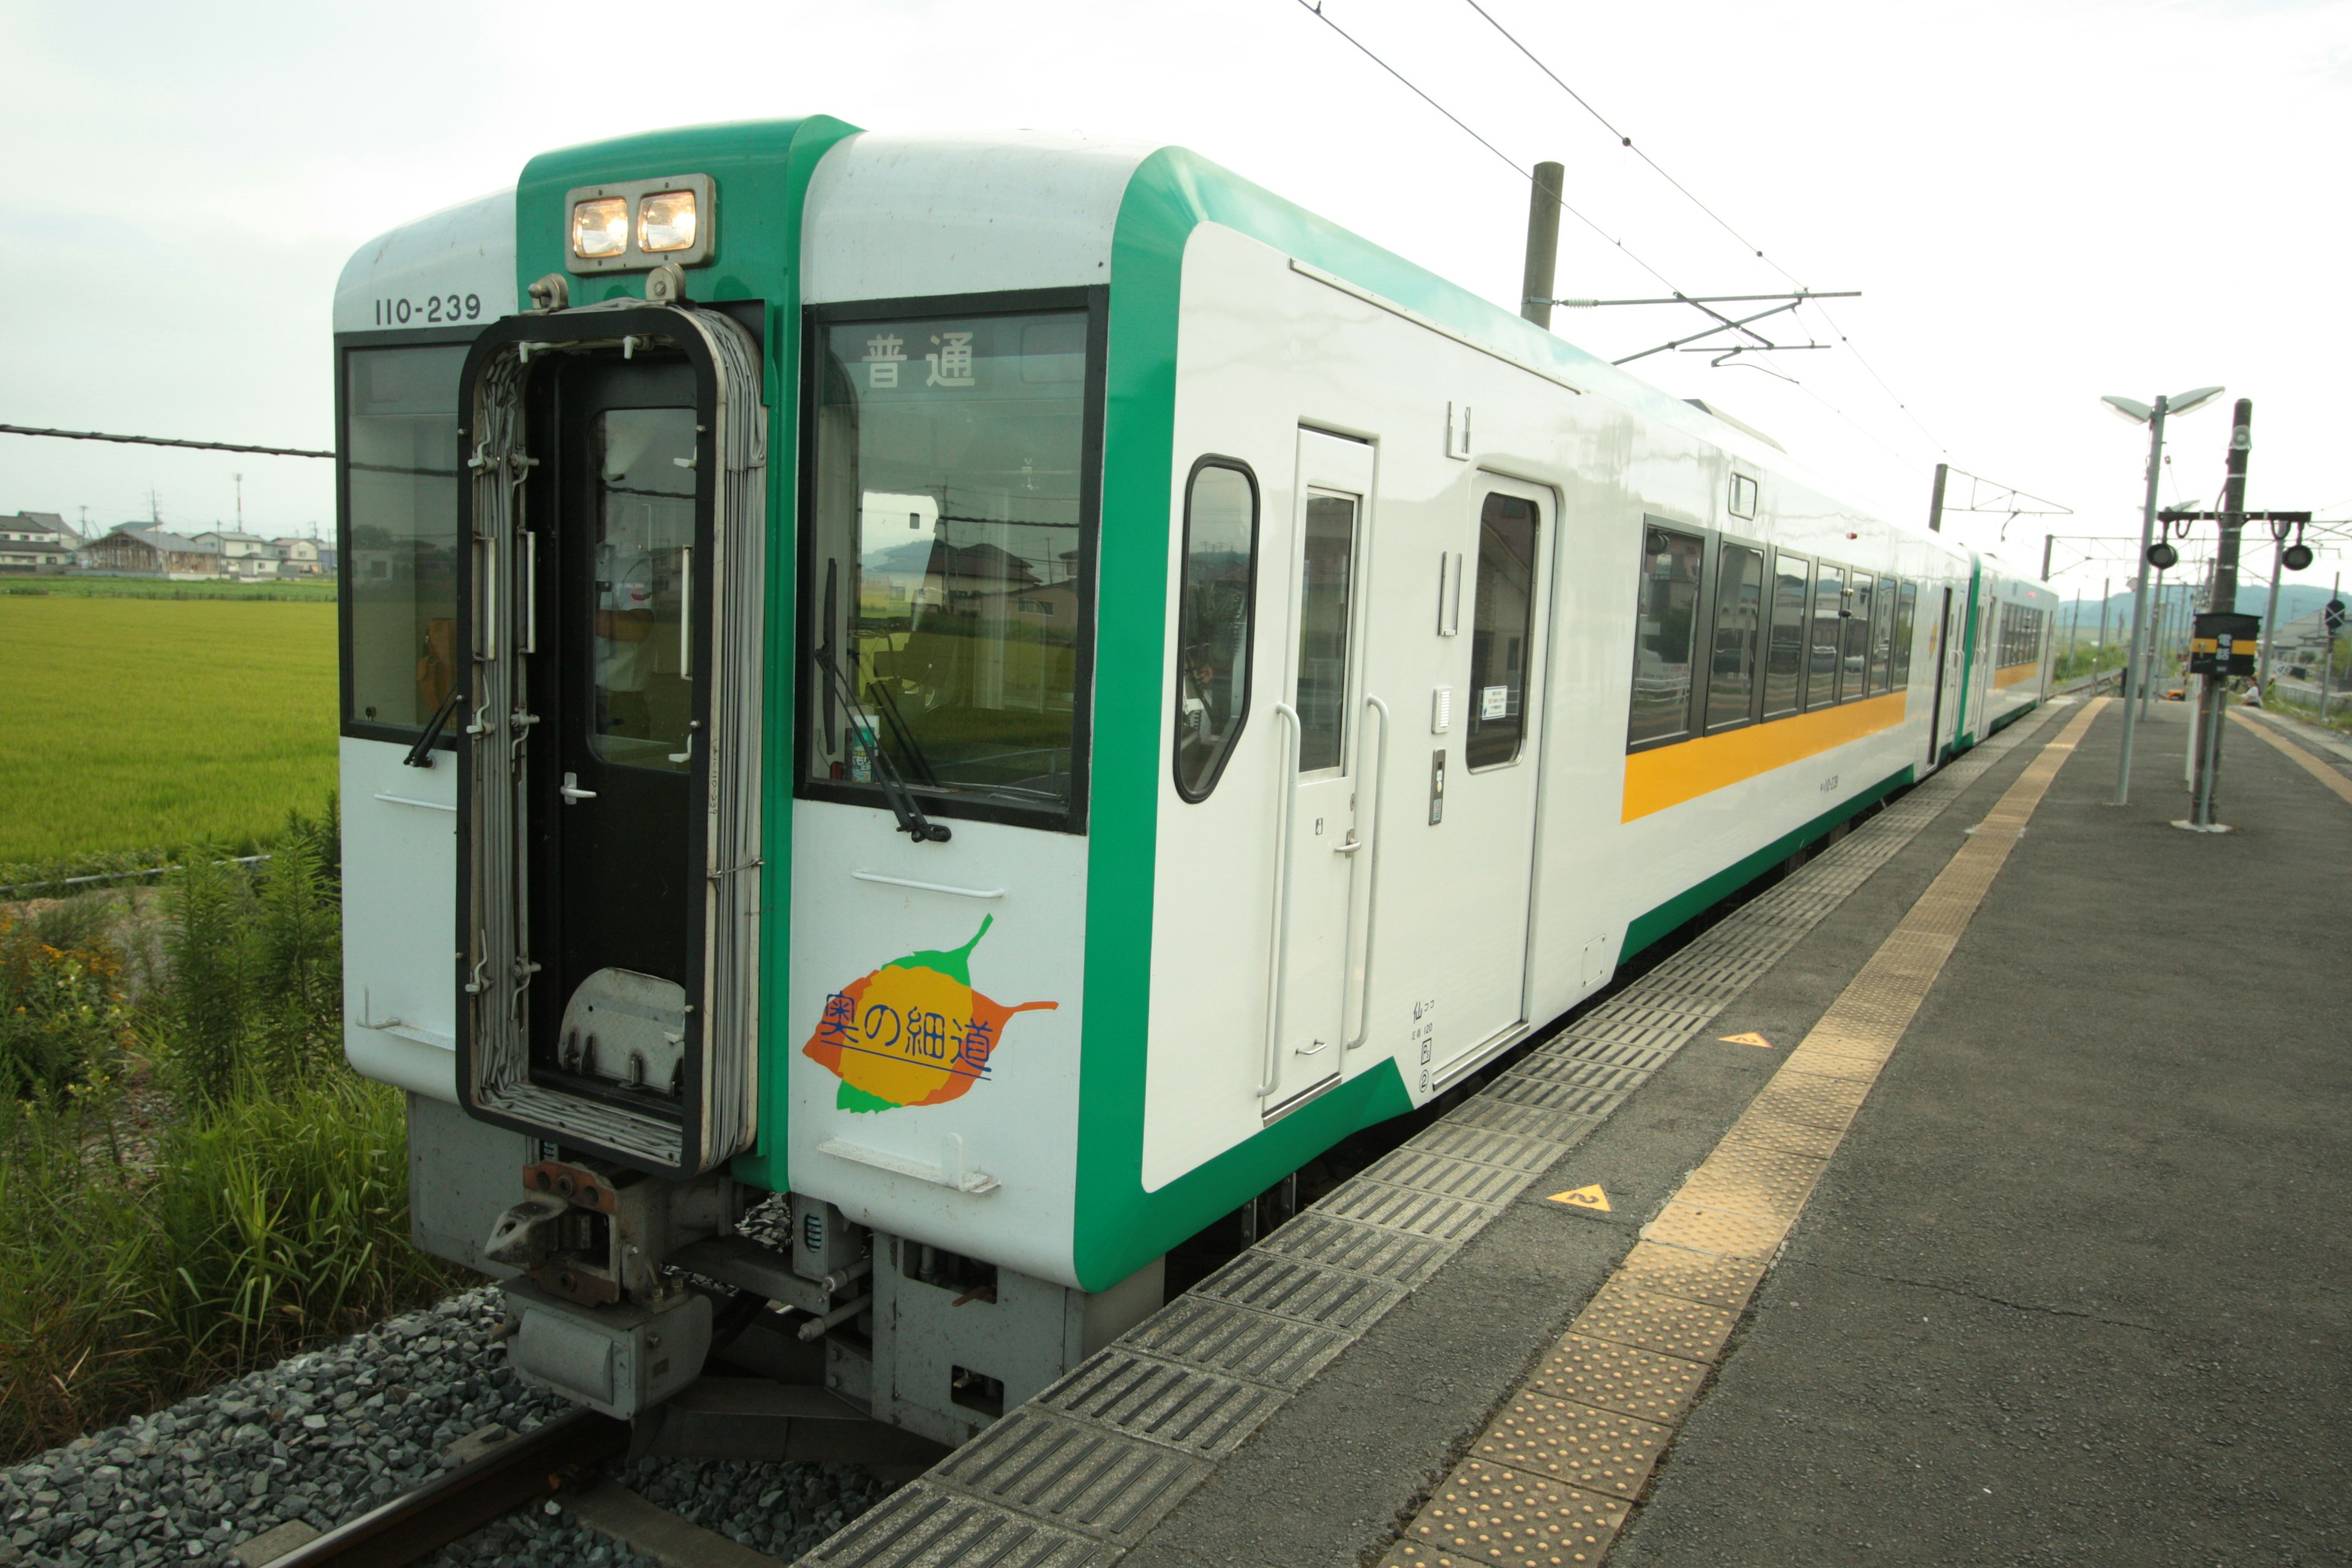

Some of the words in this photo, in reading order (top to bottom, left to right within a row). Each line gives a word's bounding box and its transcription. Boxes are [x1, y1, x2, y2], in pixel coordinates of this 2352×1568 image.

[377, 294, 480, 325] 110-239
[862, 332, 975, 388] 普通
[820, 990, 993, 1072] 奥の細道
